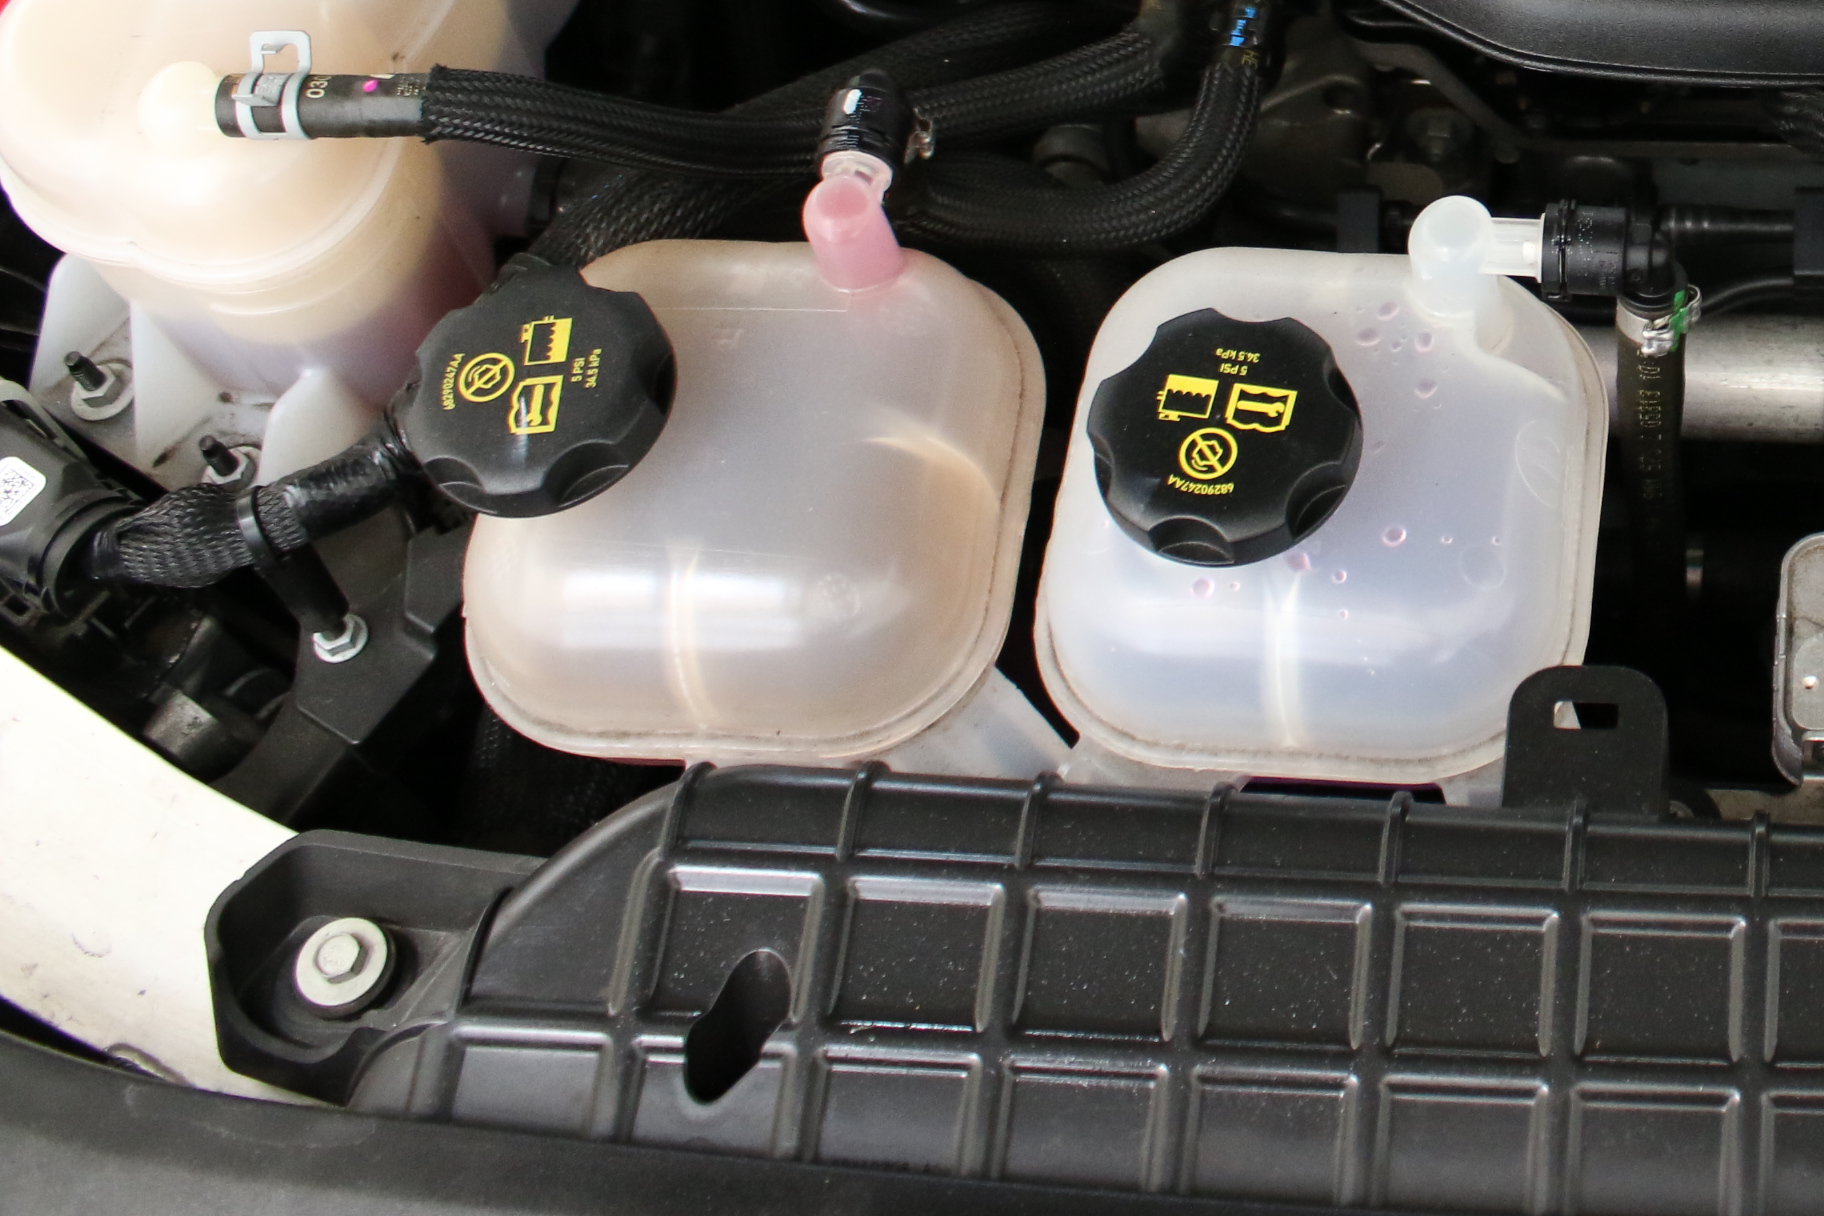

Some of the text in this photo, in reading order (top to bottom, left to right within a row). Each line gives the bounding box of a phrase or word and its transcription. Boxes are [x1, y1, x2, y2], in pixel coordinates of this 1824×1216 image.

[590, 348, 602, 367] kPa
[1215, 348, 1261, 363] 34.5 kPa
[571, 357, 585, 384] 5 PSI
[1219, 363, 1248, 375] 5 PSI
[442, 353, 466, 411] 68290247AA
[1167, 473, 1234, 496] 68290247AA
